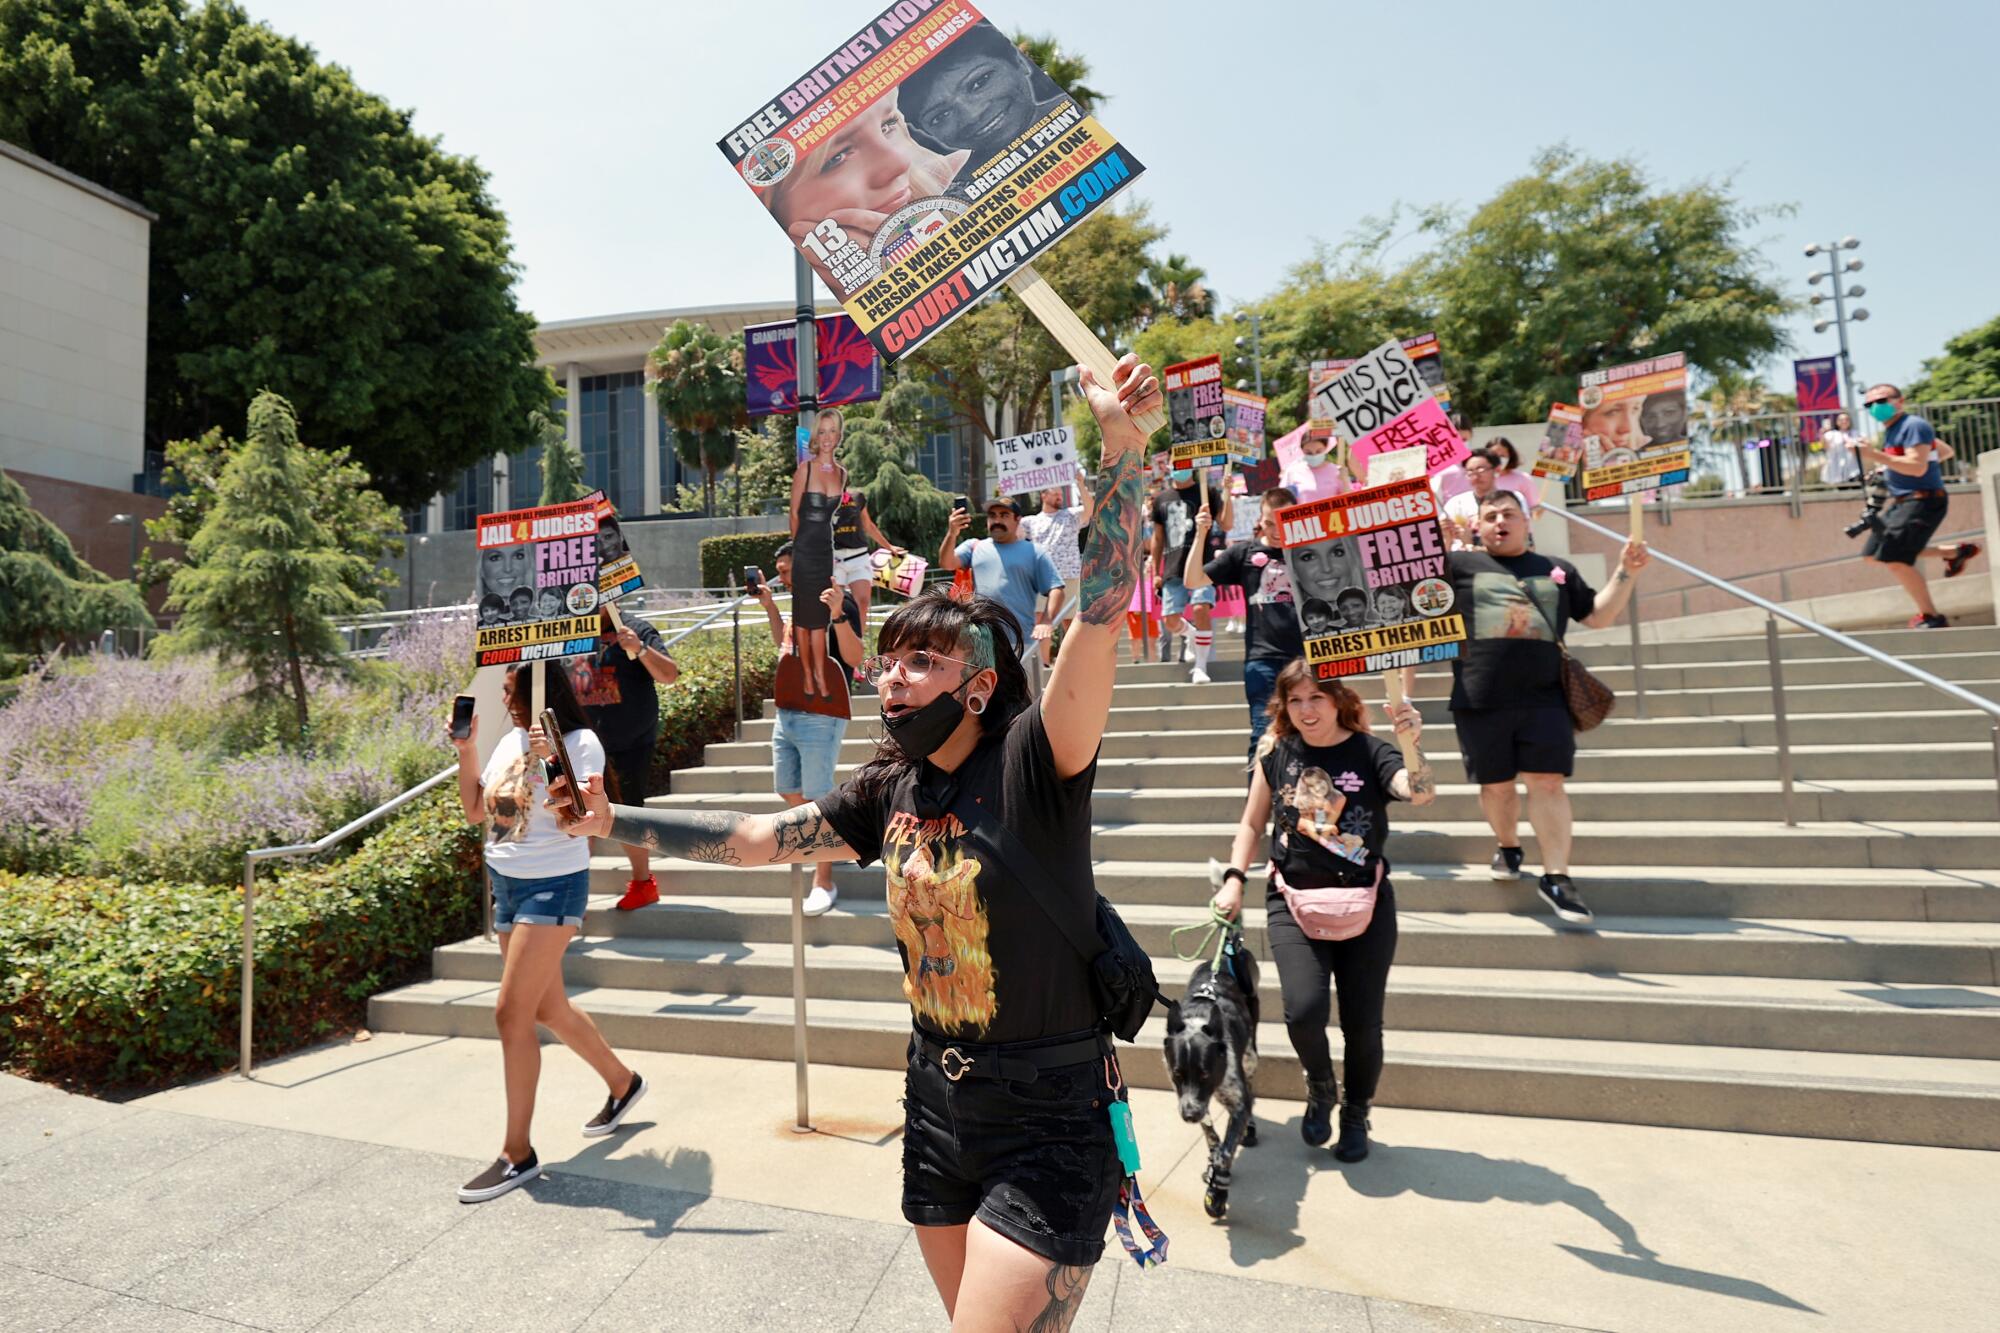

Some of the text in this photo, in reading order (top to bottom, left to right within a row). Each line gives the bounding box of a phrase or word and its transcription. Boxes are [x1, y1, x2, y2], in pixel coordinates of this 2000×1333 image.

[788, 1, 961, 139] EXPOSE LOS ANGELES COUNTY
[795, 9, 974, 152] PROBATE PREDATOR ABUSE
[729, 103, 788, 157] FREE
[780, 26, 882, 115] BRITNEY
[964, 151, 1027, 201] BRENDA
[1031, 104, 1082, 149] PENNY
[971, 99, 1073, 180] PRESIDING LOS ANGELES JUDGE
[854, 280, 892, 311] THIS
[888, 267, 909, 286] IS
[904, 233, 951, 273] WHAT
[948, 184, 1017, 240] HAPPENS
[1012, 150, 1062, 190] WHEN
[1057, 126, 1092, 156] ONE
[866, 279, 922, 323] PERSON
[916, 247, 962, 284] TAKES
[958, 203, 1022, 253] CONTROL
[1018, 190, 1038, 208] OF
[1035, 162, 1076, 193] YOUR
[1071, 140, 1103, 167] LIFE
[801, 218, 848, 262] 13
[823, 240, 860, 270] YEARS
[880, 151, 1130, 353] COURTVICTIM.COM
[831, 262, 846, 279] OF
[843, 249, 868, 270] LIES
[839, 258, 873, 288] FRAUD
[752, 330, 778, 345] GRAND
[1193, 381, 1223, 409] FREE
[1316, 347, 1407, 410] THIS IS
[1581, 370, 1608, 388] FREE
[1335, 368, 1423, 438] TOXIC!
[996, 429, 1067, 455] THE WORLD
[1173, 445, 1196, 457] ARREST
[1197, 441, 1214, 453] THEM
[1215, 440, 1226, 451] ALL
[1371, 412, 1428, 453] FREE
[999, 460, 1077, 494] #FREEBRITNEY
[1280, 480, 1428, 520] JUSTICE FOR ALL PROBATE VICTIMS
[1283, 515, 1328, 546] JAIL
[1328, 511, 1345, 534] 4
[1346, 491, 1434, 532] JUDGES
[480, 512, 596, 547] JAIL 4 JUDGES
[1357, 519, 1443, 569] FREE
[535, 536, 597, 571] FREE
[1364, 556, 1445, 589] BRITNEY
[536, 565, 597, 588] BRITNEY
[479, 626, 532, 647] ARREST
[534, 620, 571, 640] THEM
[575, 616, 597, 634] ALL
[1309, 631, 1373, 659] ARREST
[1375, 622, 1426, 648] THEM
[1430, 617, 1461, 639] ALL
[481, 637, 594, 666] COURTVICTIM.COM
[1317, 642, 1460, 679] COURTVICTIM.COM
